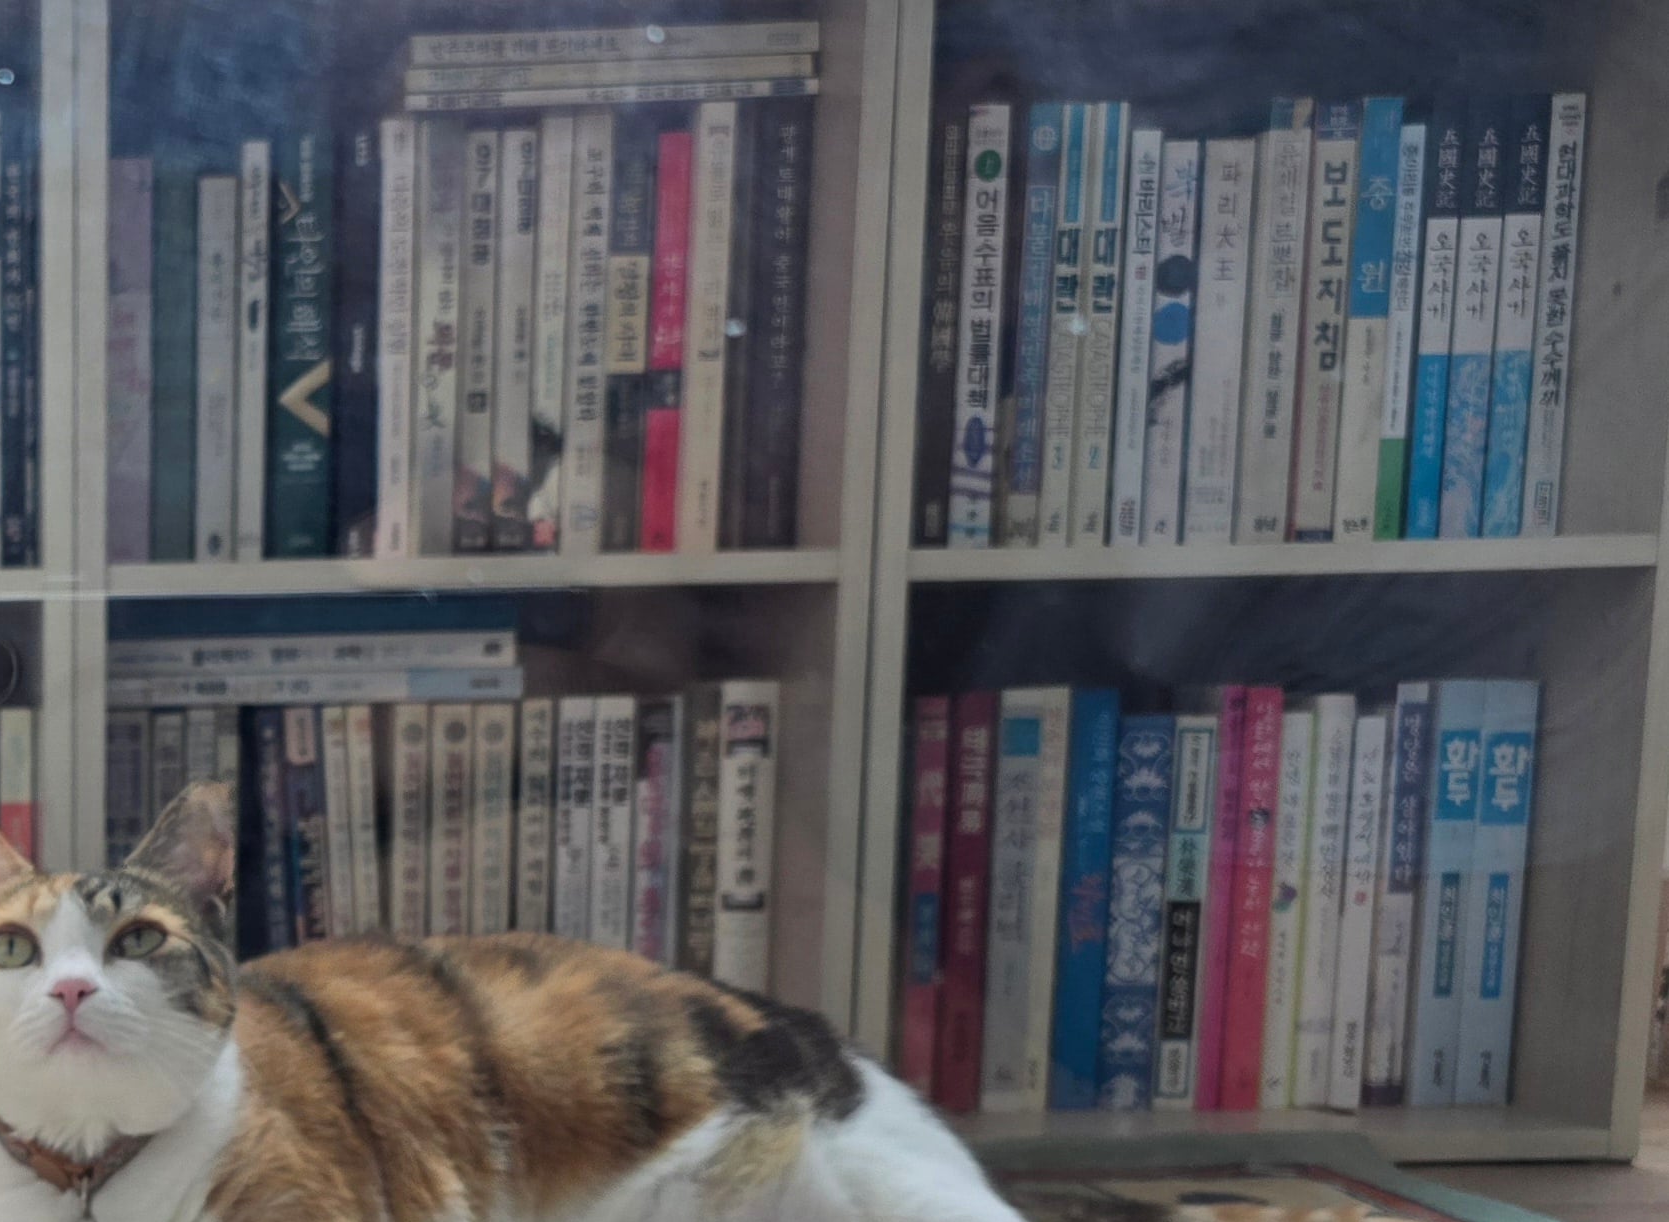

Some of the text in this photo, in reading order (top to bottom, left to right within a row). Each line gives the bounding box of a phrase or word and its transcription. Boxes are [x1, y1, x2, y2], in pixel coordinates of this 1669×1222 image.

[1550, 140, 1577, 241] 현대과학도
[969, 187, 999, 313] 어음수표의
[1314, 160, 1348, 373] 보도지침
[1426, 230, 1454, 322] 오국사기
[1466, 230, 1494, 322] 오국사기
[1507, 228, 1535, 320] 오국사기
[1442, 735, 1480, 807] 화두
[1489, 742, 1530, 813] 화두
